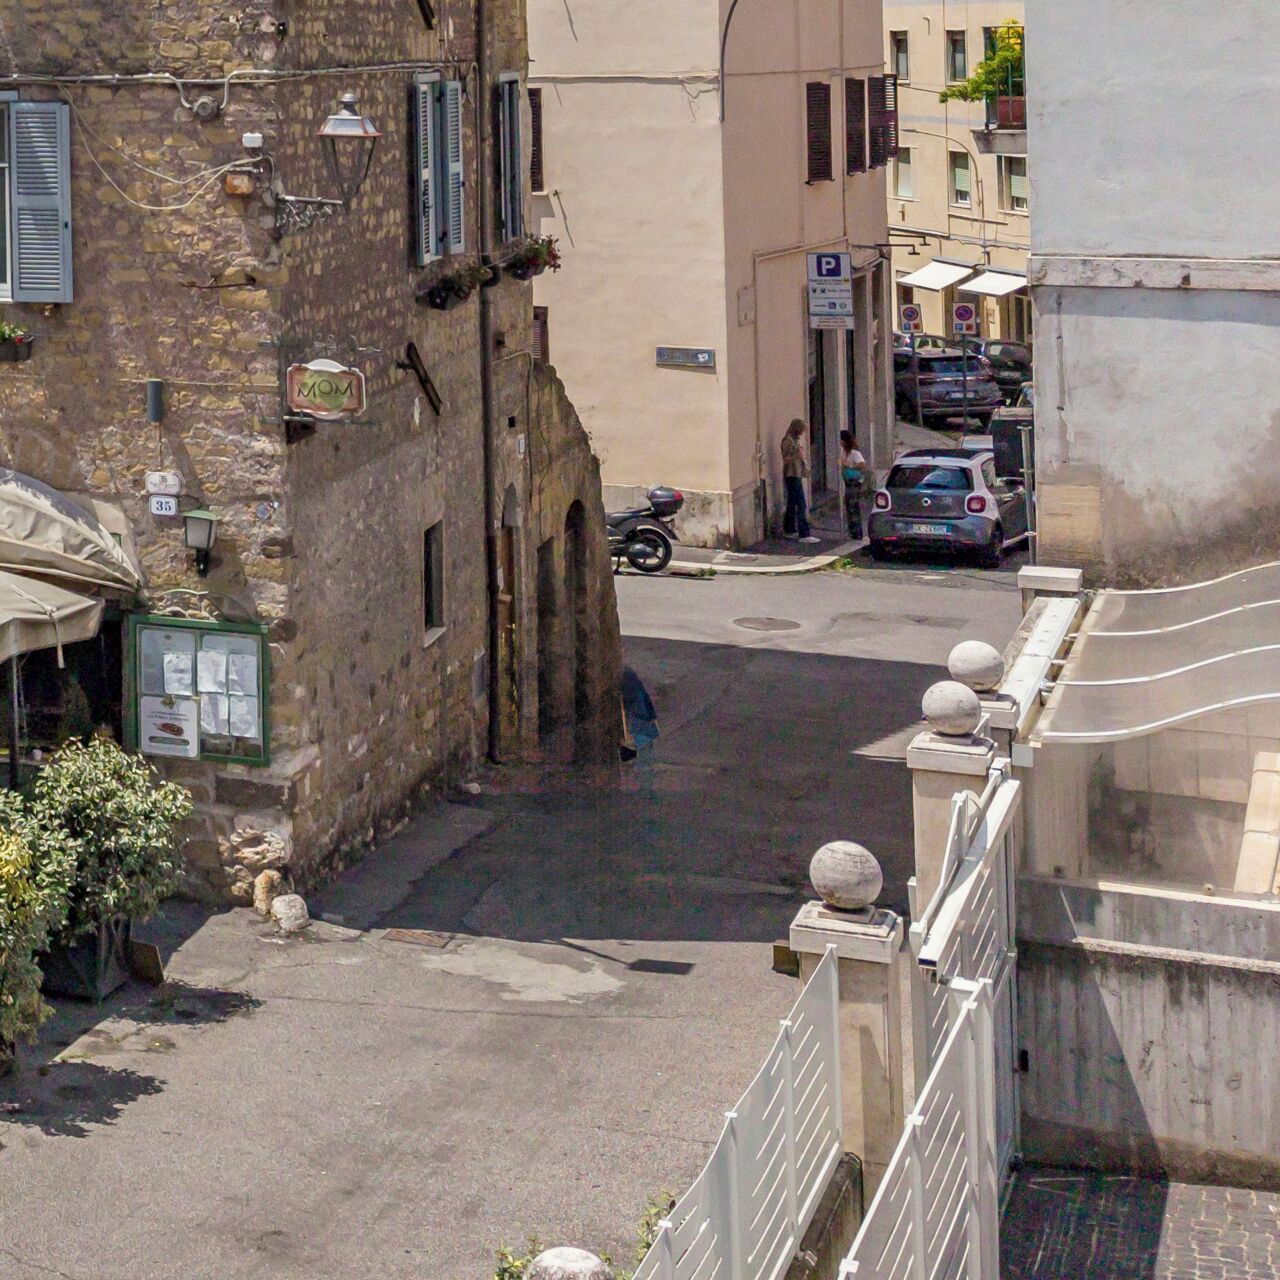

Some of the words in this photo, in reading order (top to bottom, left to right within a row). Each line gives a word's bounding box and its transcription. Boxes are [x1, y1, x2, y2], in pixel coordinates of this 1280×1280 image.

[821, 257, 836, 275] P
[297, 379, 354, 399] MOM
[156, 500, 172, 512] 35
